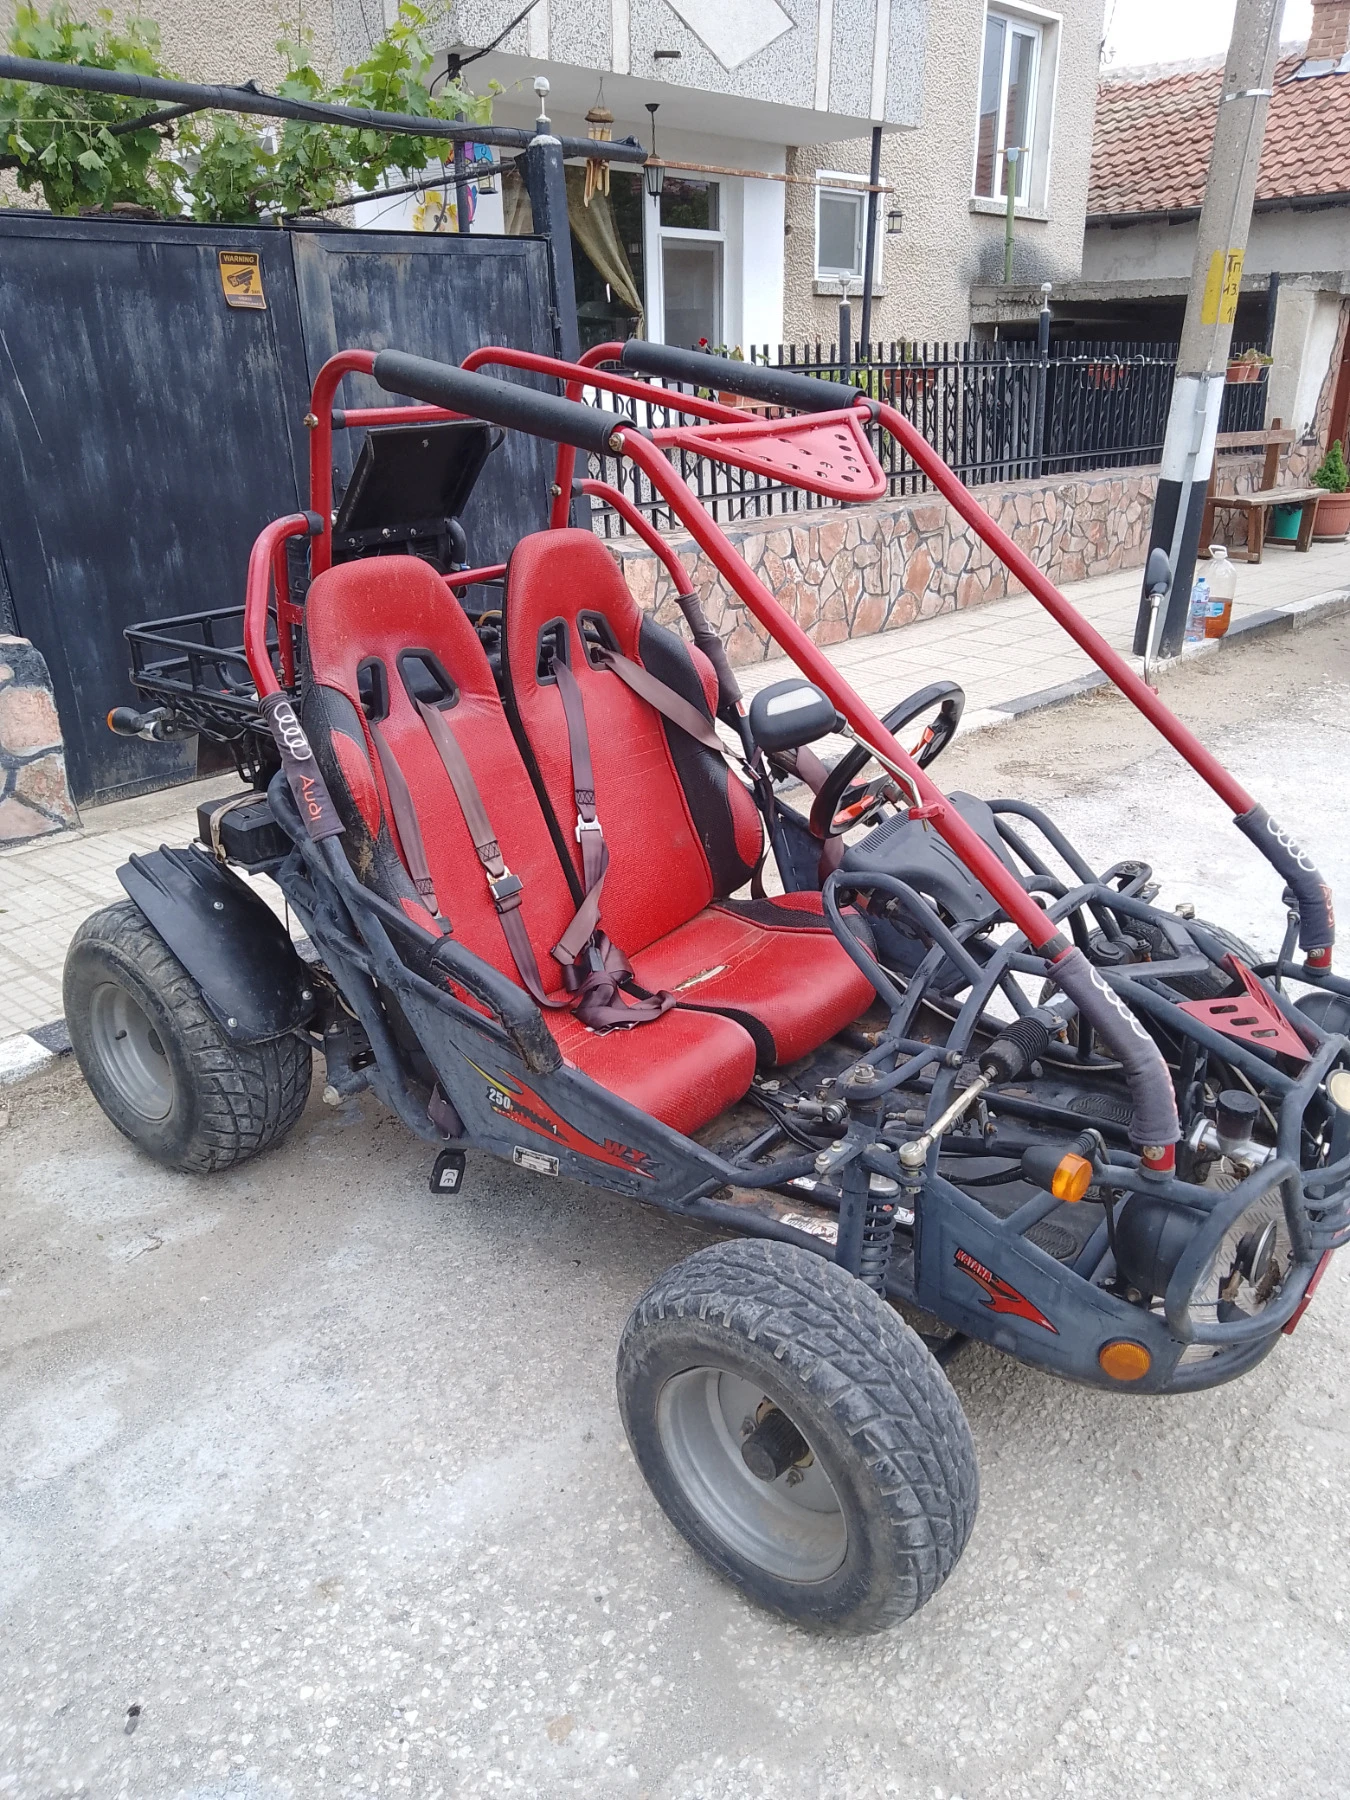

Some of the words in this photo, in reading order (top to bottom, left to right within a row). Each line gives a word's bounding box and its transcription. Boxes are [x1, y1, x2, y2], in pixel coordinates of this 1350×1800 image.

[223, 254, 255, 263] WARNING
[300, 774, 323, 821] Audi
[488, 1088, 512, 1110] 250
[443, 1171, 456, 1184] CE
[955, 1249, 993, 1283] KATANA
